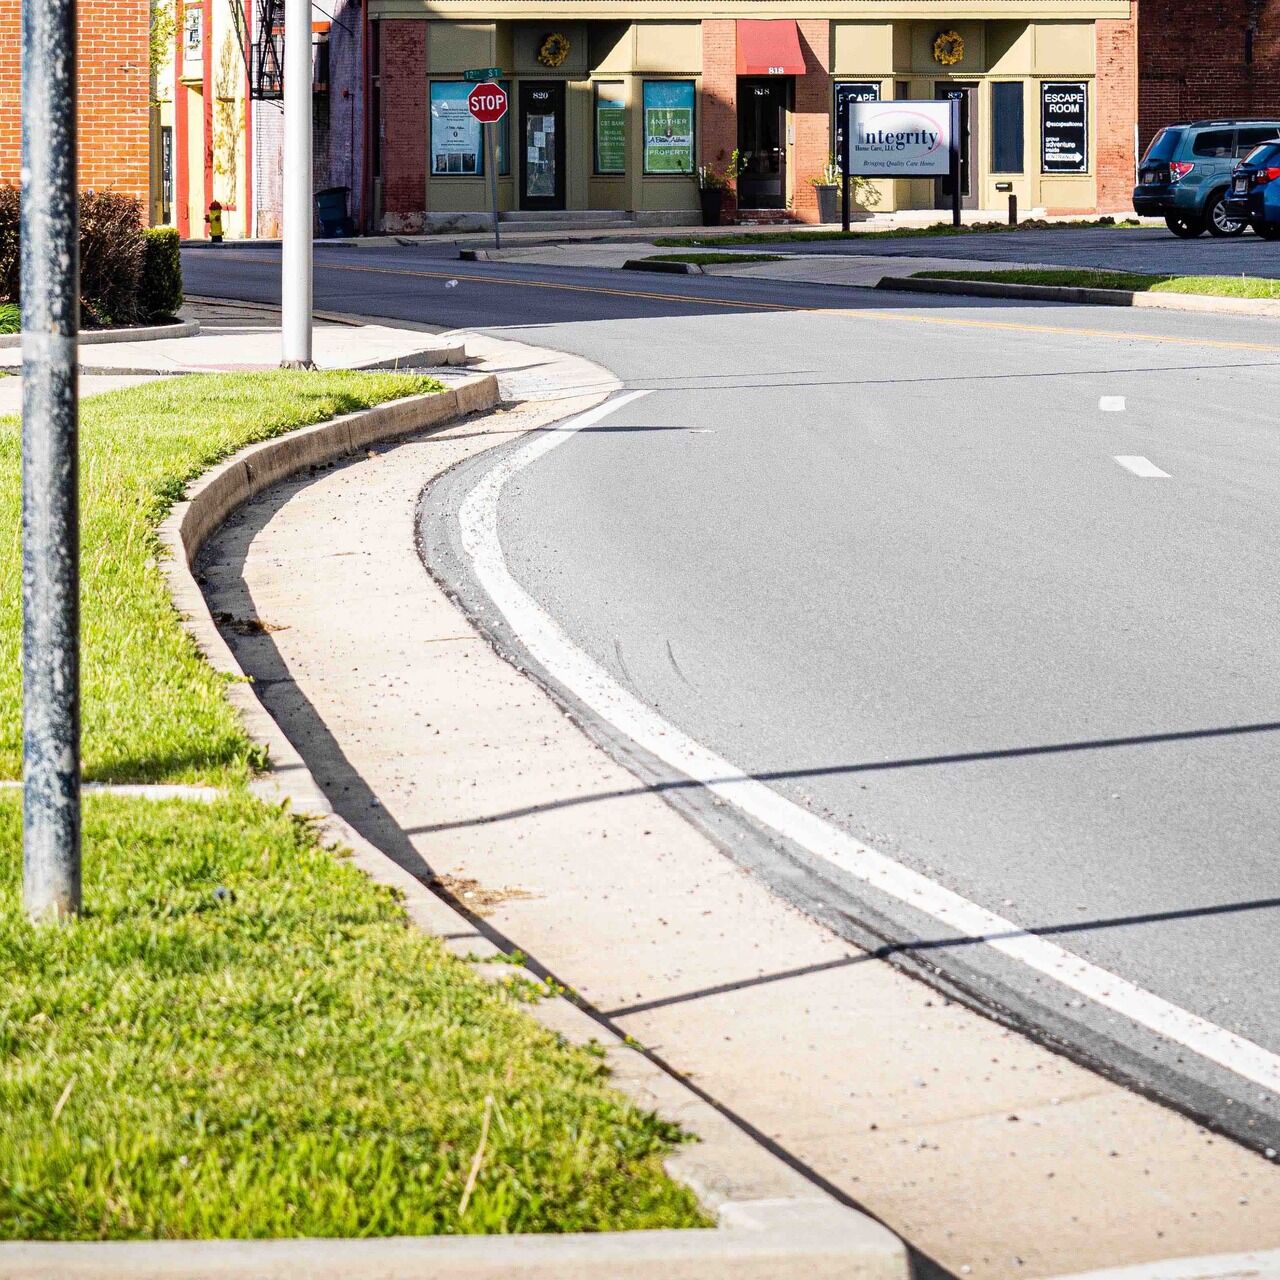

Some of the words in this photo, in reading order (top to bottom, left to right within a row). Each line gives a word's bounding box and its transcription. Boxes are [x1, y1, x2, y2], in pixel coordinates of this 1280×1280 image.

[488, 69, 498, 78] ST
[768, 66, 784, 74] 818
[838, 93, 875, 102] ECAPE
[1045, 94, 1084, 102] ESCAPE
[471, 95, 504, 111] STOP
[1049, 104, 1079, 113] ROOM
[857, 122, 937, 150] Integrity
[863, 160, 885, 168] Bringing
